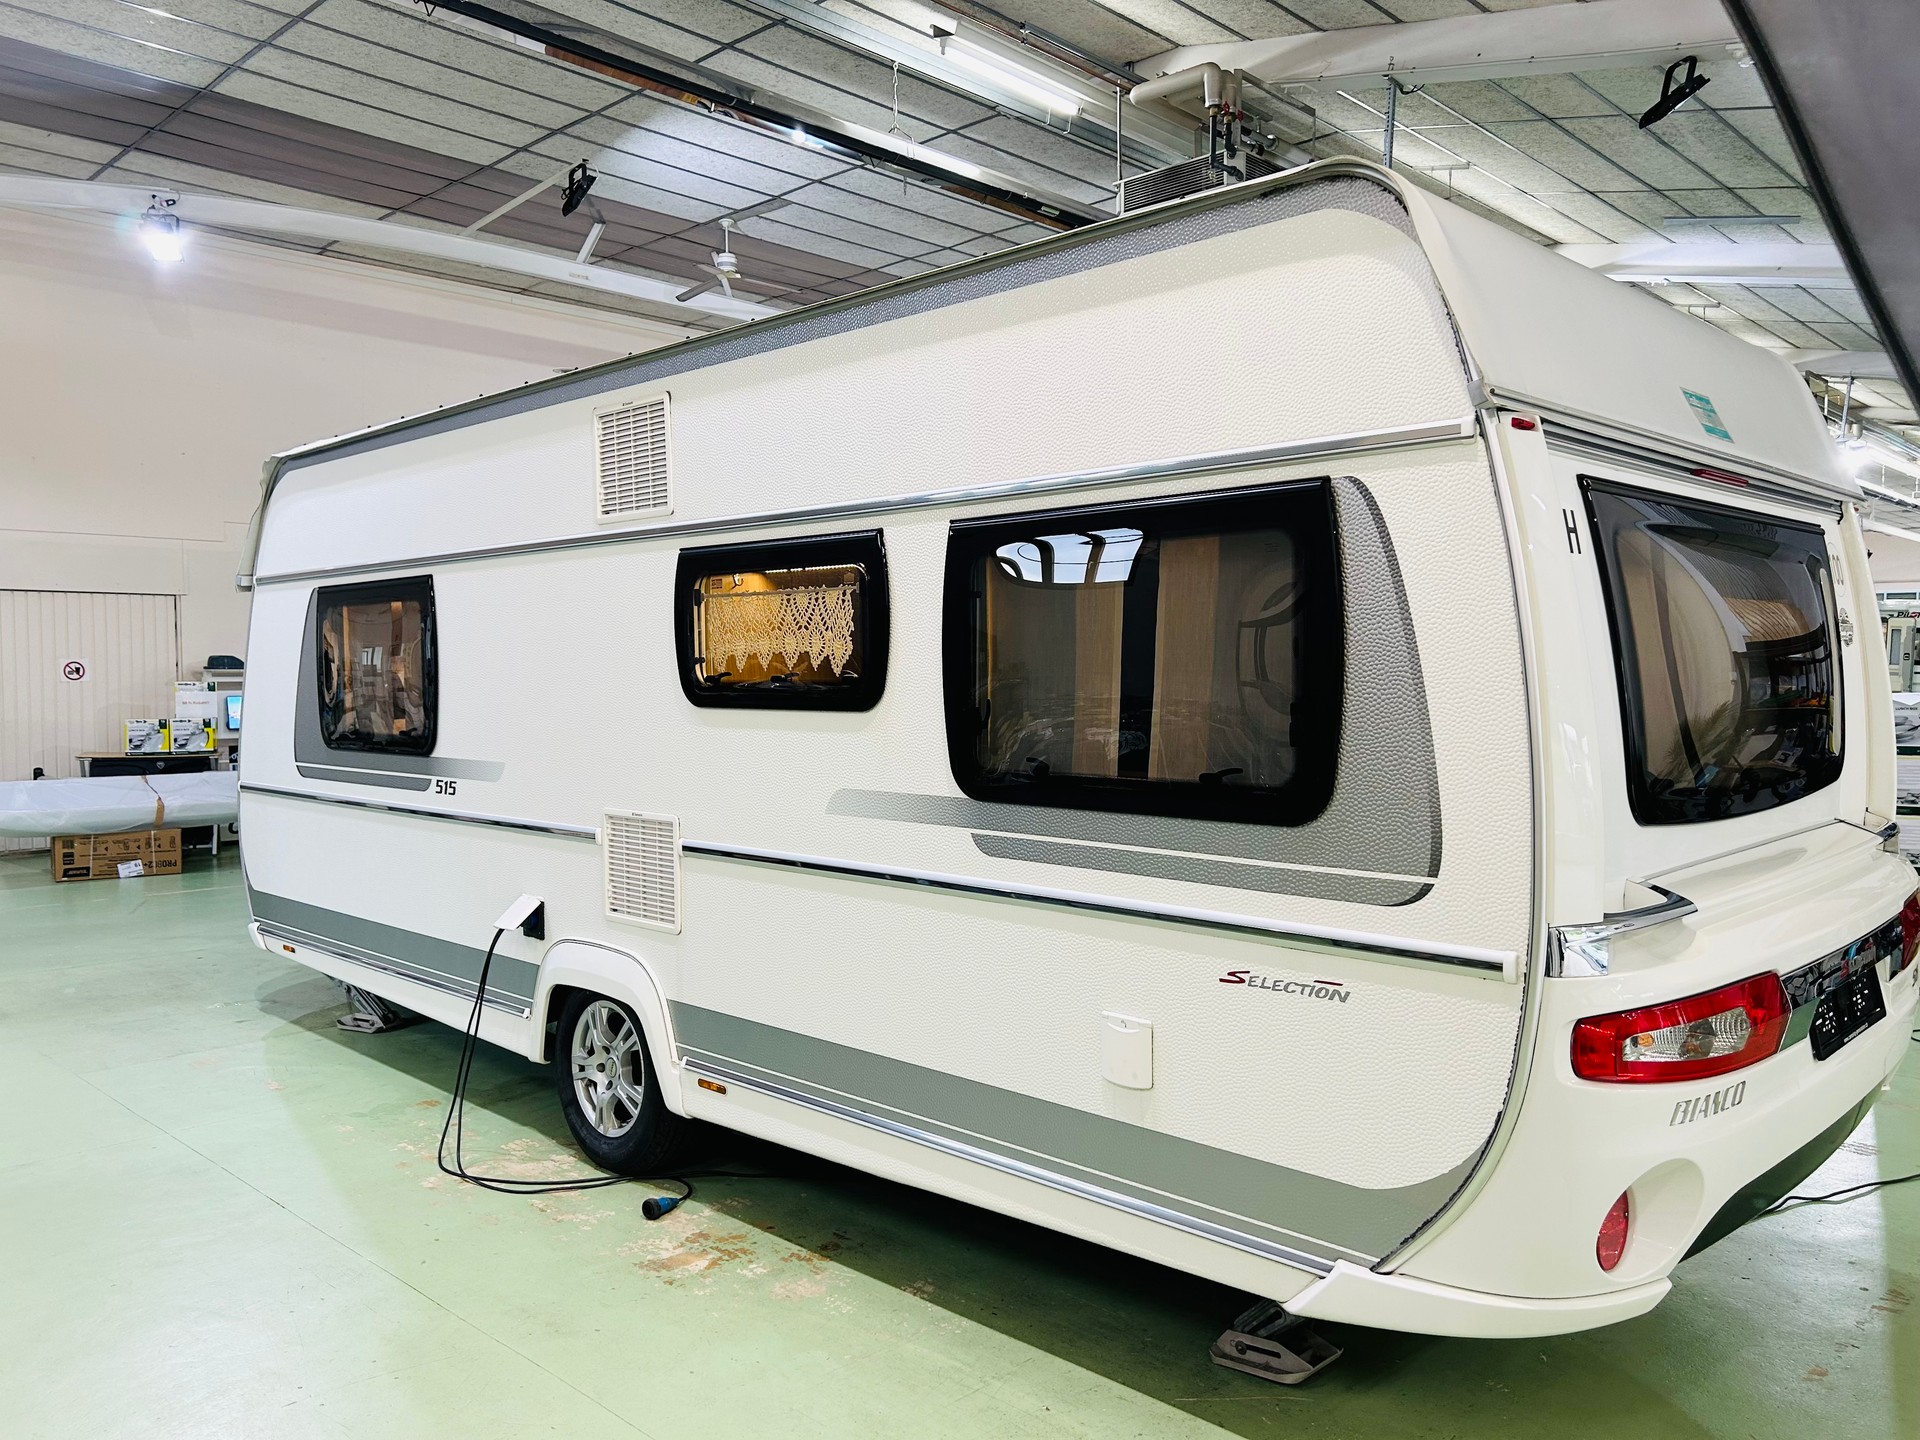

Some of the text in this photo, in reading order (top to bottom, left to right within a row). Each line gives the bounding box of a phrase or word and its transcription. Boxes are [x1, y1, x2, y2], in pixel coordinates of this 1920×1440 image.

[1562, 508, 1582, 555] H
[435, 779, 457, 796] 515
[1669, 1080, 1746, 1127] BIANCO
